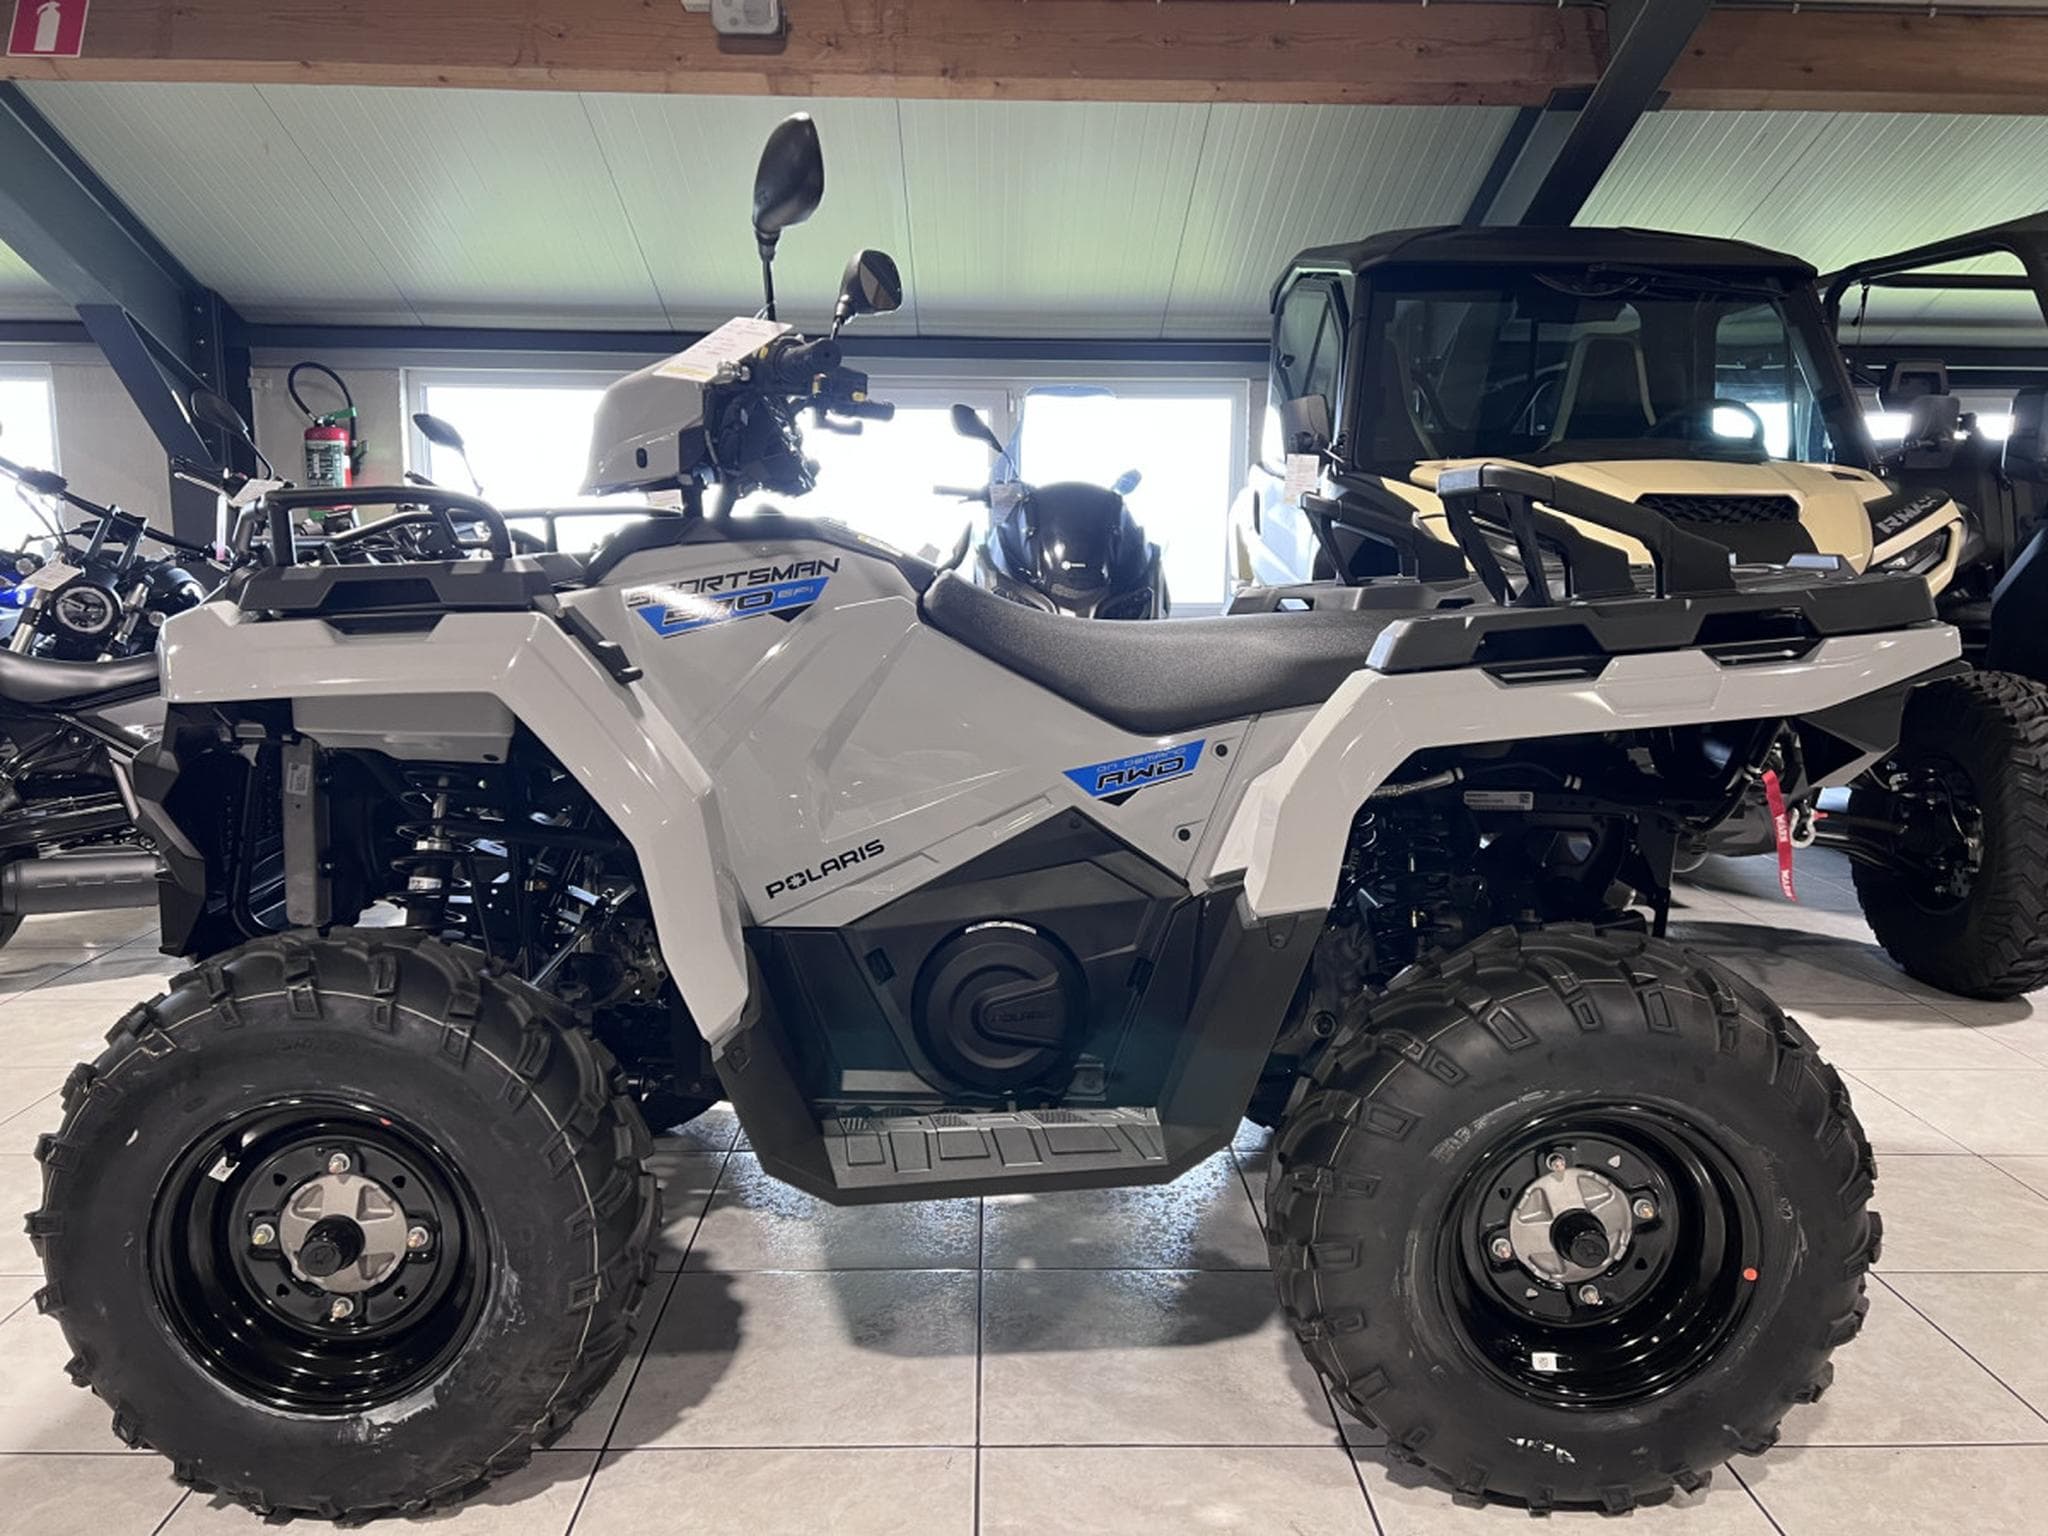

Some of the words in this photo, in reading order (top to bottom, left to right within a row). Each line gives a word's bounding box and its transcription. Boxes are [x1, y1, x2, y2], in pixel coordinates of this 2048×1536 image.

[626, 557, 841, 608] SORTSMAN
[1096, 756, 1185, 790] AWD
[765, 838, 885, 900] POLARIS
